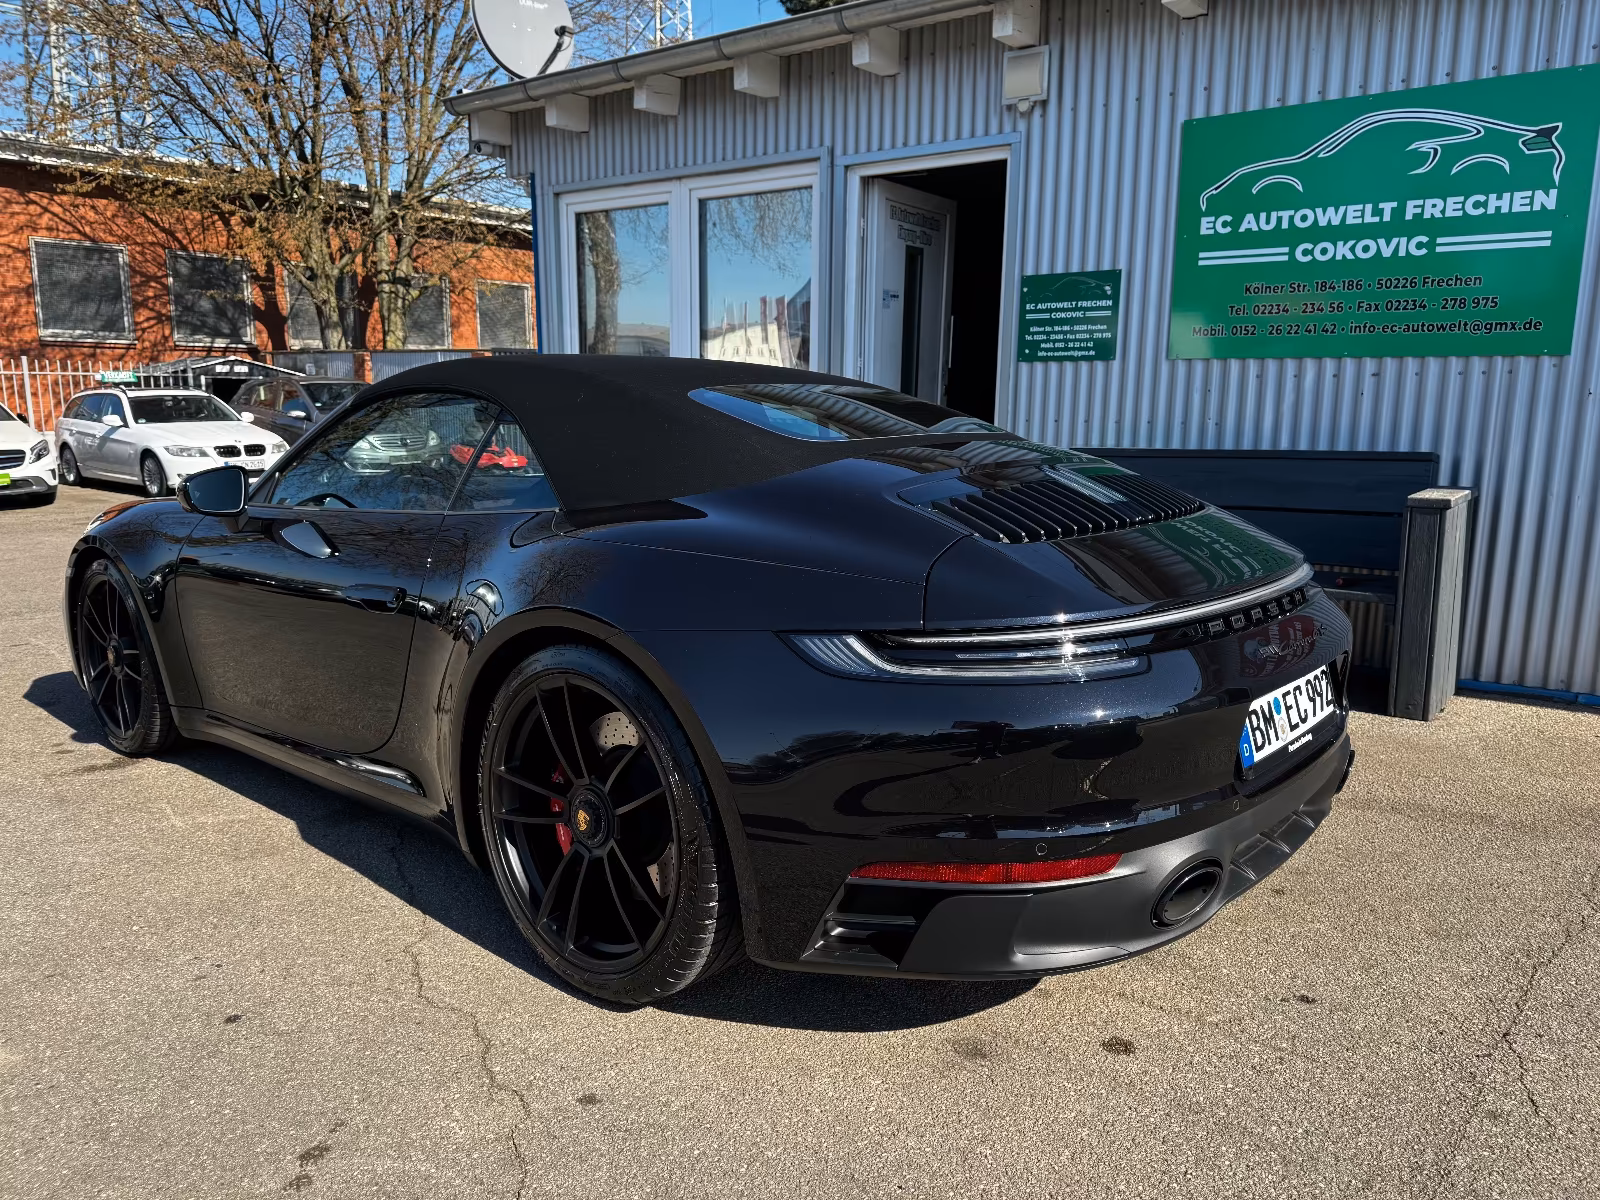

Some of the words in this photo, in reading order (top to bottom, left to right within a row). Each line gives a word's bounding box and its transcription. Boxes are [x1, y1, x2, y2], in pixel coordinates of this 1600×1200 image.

[1200, 215, 1233, 235] EC
[1238, 202, 1398, 232] AUTOWELT
[1405, 189, 1558, 220] FRECHEN
[1295, 235, 1430, 262] COKOVIC
[1244, 282, 1285, 296] Kölner
[1288, 281, 1311, 294] Str.
[1314, 278, 1363, 293] 184-186
[1375, 276, 1418, 291] 50226
[1421, 273, 1483, 289] Frechen
[1036, 301, 1077, 310] AUTOWELT
[1077, 299, 1113, 308] FRECHEN
[1051, 311, 1085, 319] COKOVIC
[1228, 304, 1249, 317] Tel.
[1252, 303, 1290, 316] 02234
[1301, 301, 1325, 315] 234
[1328, 300, 1344, 314] 56
[1355, 300, 1381, 313] Fax
[1384, 298, 1428, 312] 02234
[1440, 297, 1468, 311] 278
[1471, 295, 1499, 310] 975
[1192, 324, 1227, 338] Mobil.
[1230, 323, 1257, 337] 0152
[1267, 323, 1283, 336] 26
[1286, 323, 1301, 336] 22
[1304, 323, 1317, 336] 41
[1320, 322, 1337, 336] 42
[1348, 317, 1543, 336] info-ec-autowelt@gmx.de
[1248, 700, 1280, 754] BM
[1282, 685, 1309, 733] EC
[1243, 743, 1250, 757] D
